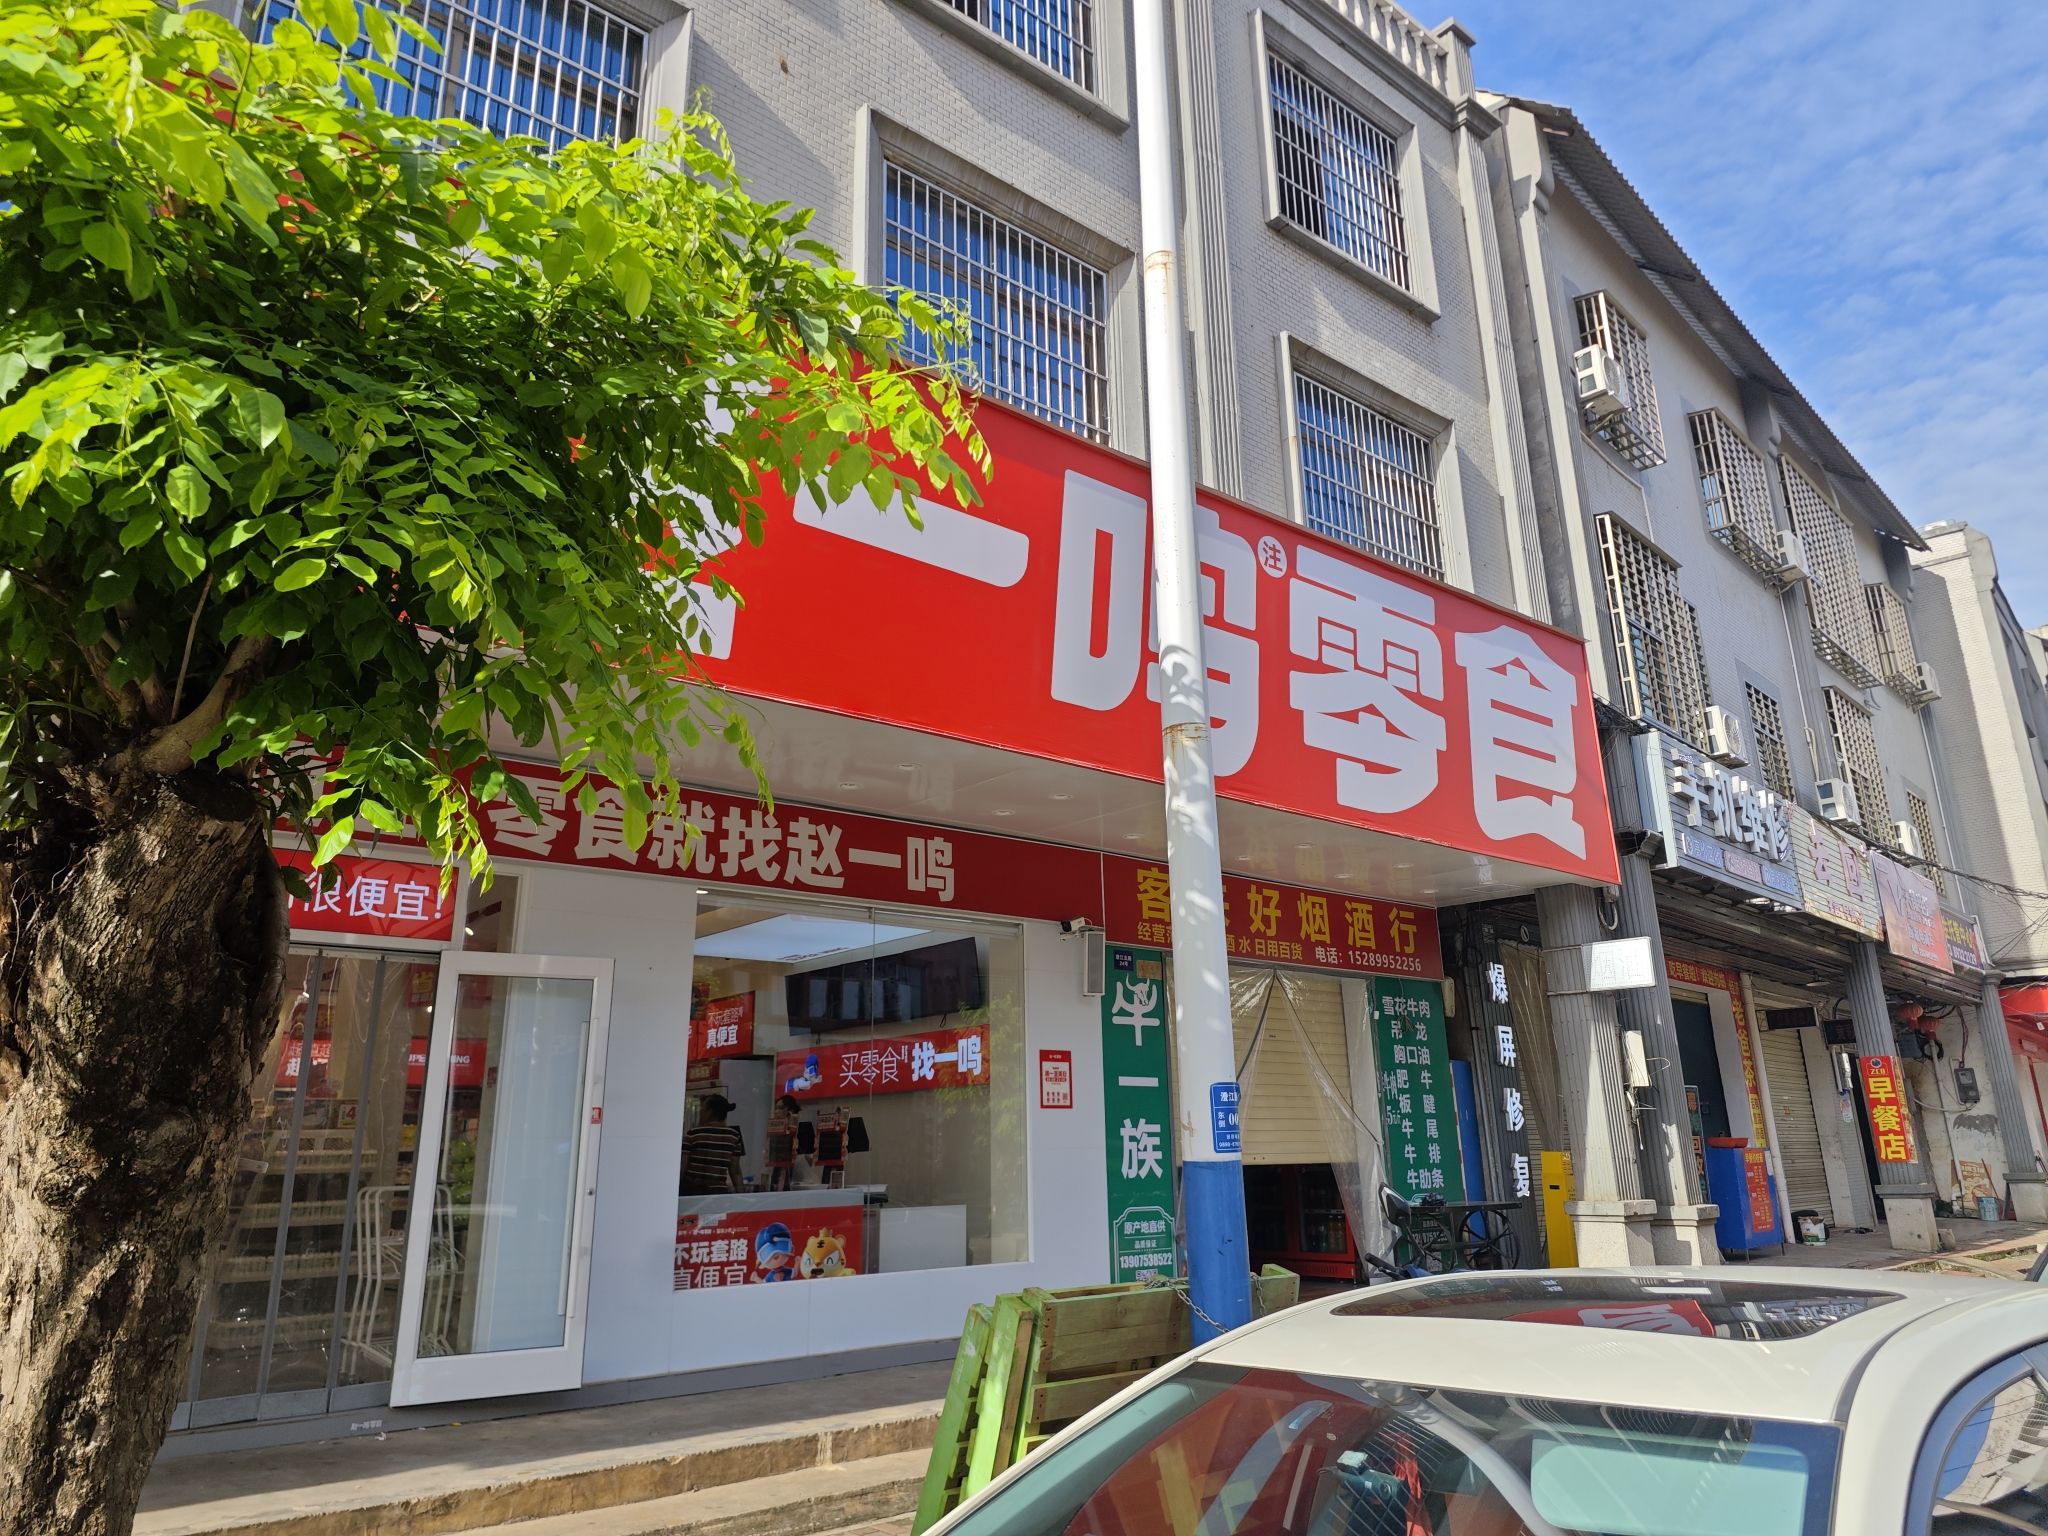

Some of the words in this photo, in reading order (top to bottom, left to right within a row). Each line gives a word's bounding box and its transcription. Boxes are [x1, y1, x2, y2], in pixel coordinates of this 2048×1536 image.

[1671, 749, 1789, 863] 手机维修
[1136, 867, 1418, 954] 客好烟酒行
[1255, 940, 1304, 960] 日用百货
[1347, 949, 1422, 972] 15289952256
[1382, 995, 1431, 1018] 雪花牛肉
[706, 1023, 739, 1050] 真便宜
[1393, 1044, 1431, 1066] 胸口油
[1485, 961, 1531, 1198] 爆屏修复
[1868, 1077, 1907, 1161] 早餐店
[1407, 1167, 1444, 1190] 牛肋条
[1124, 1219, 1166, 1235] 原产地直供
[674, 1239, 748, 1265] 不玩套路
[1120, 1252, 1173, 1269] 13907538522
